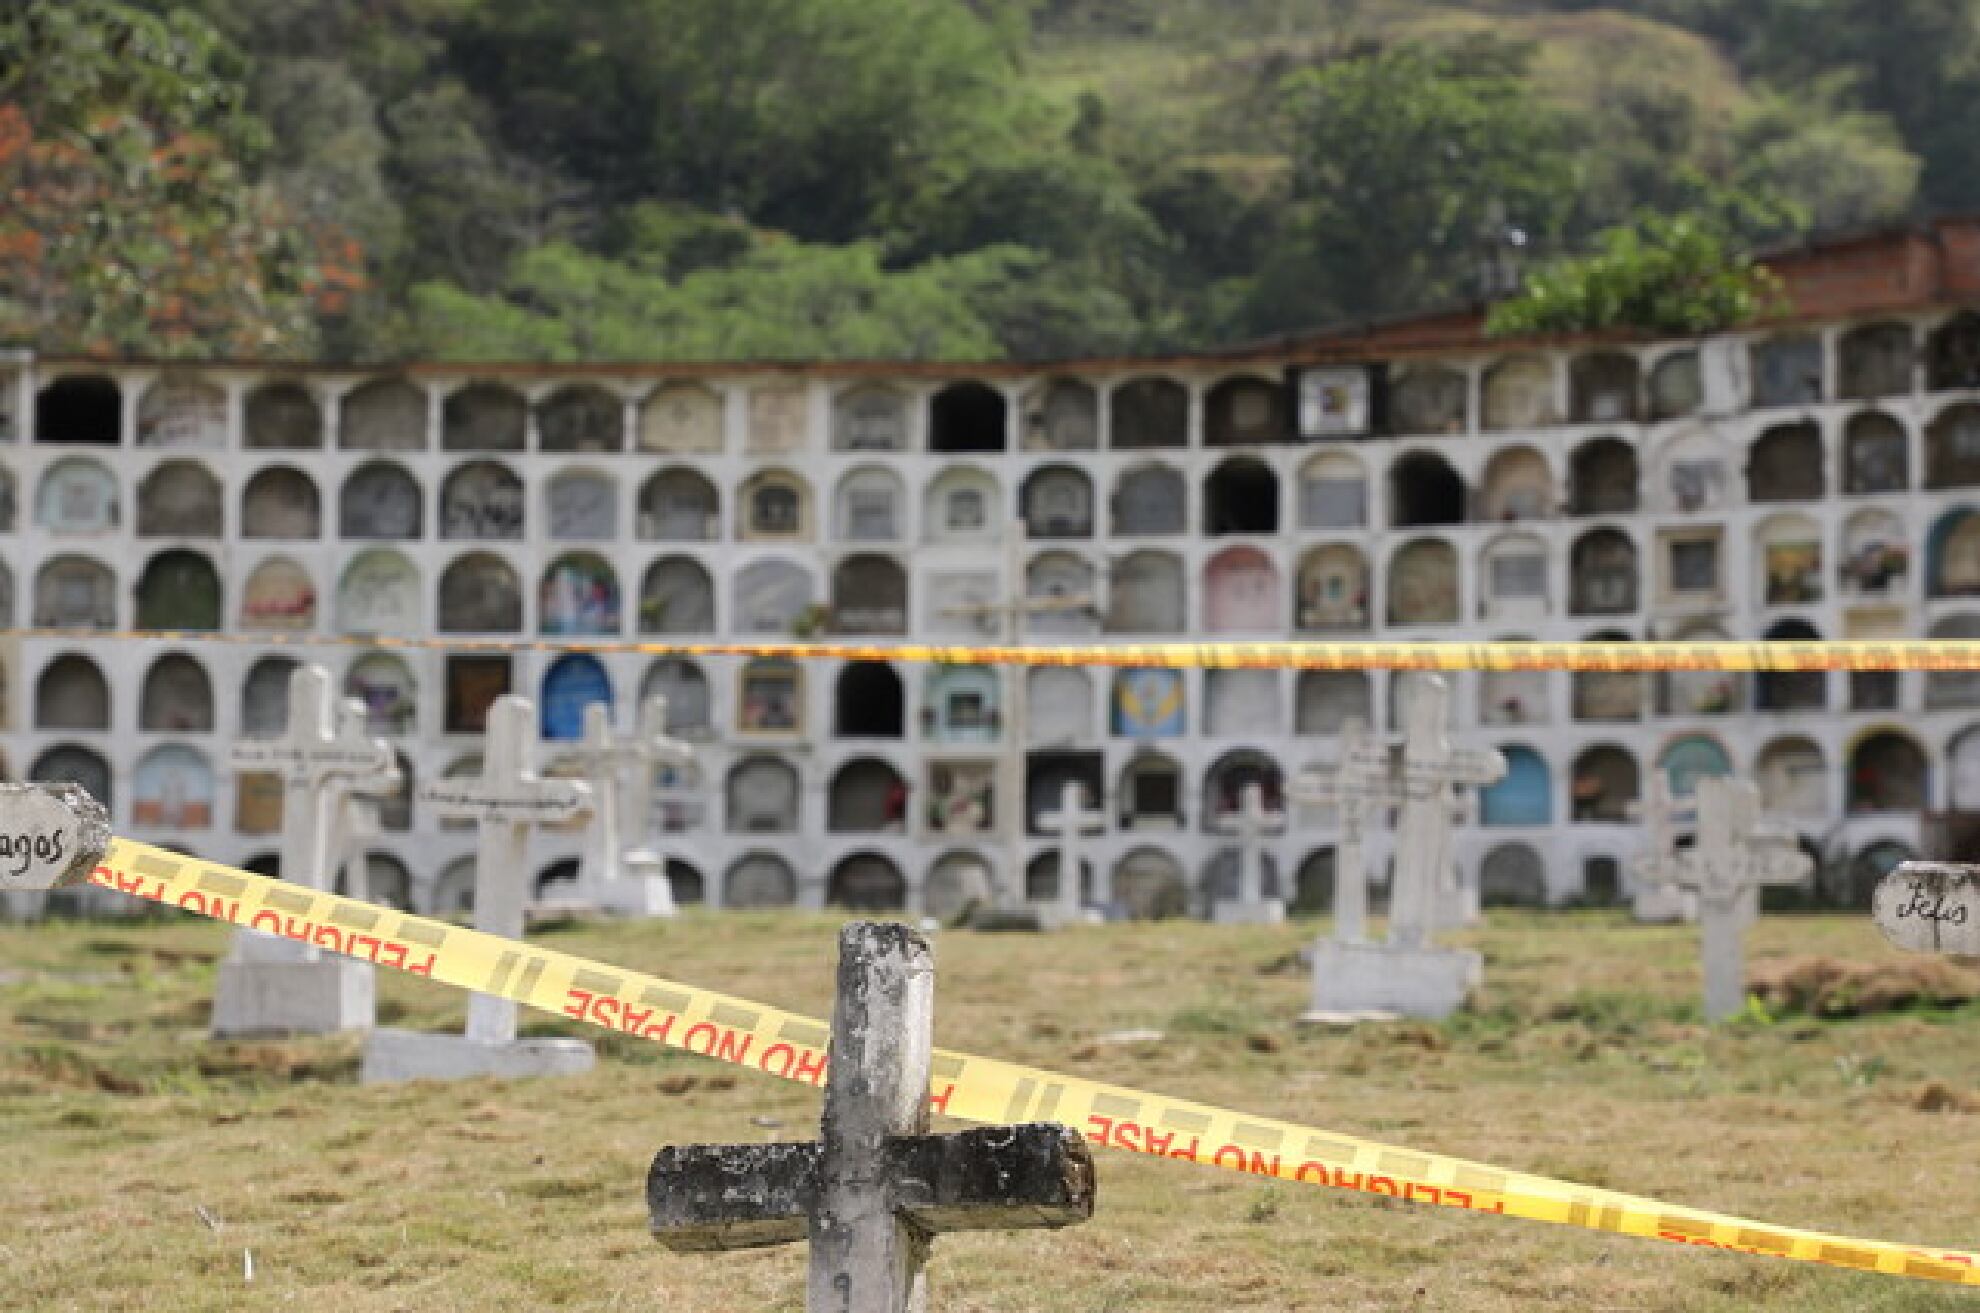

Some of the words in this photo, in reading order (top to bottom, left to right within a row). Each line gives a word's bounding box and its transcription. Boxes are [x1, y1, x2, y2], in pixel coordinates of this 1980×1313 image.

[87, 865, 165, 900] PAS
[180, 891, 240, 922] NO
[563, 989, 675, 1042] PASE
[684, 1021, 752, 1064] NO
[1087, 1114, 1199, 1161] PASE
[1214, 1145, 1281, 1176] NO
